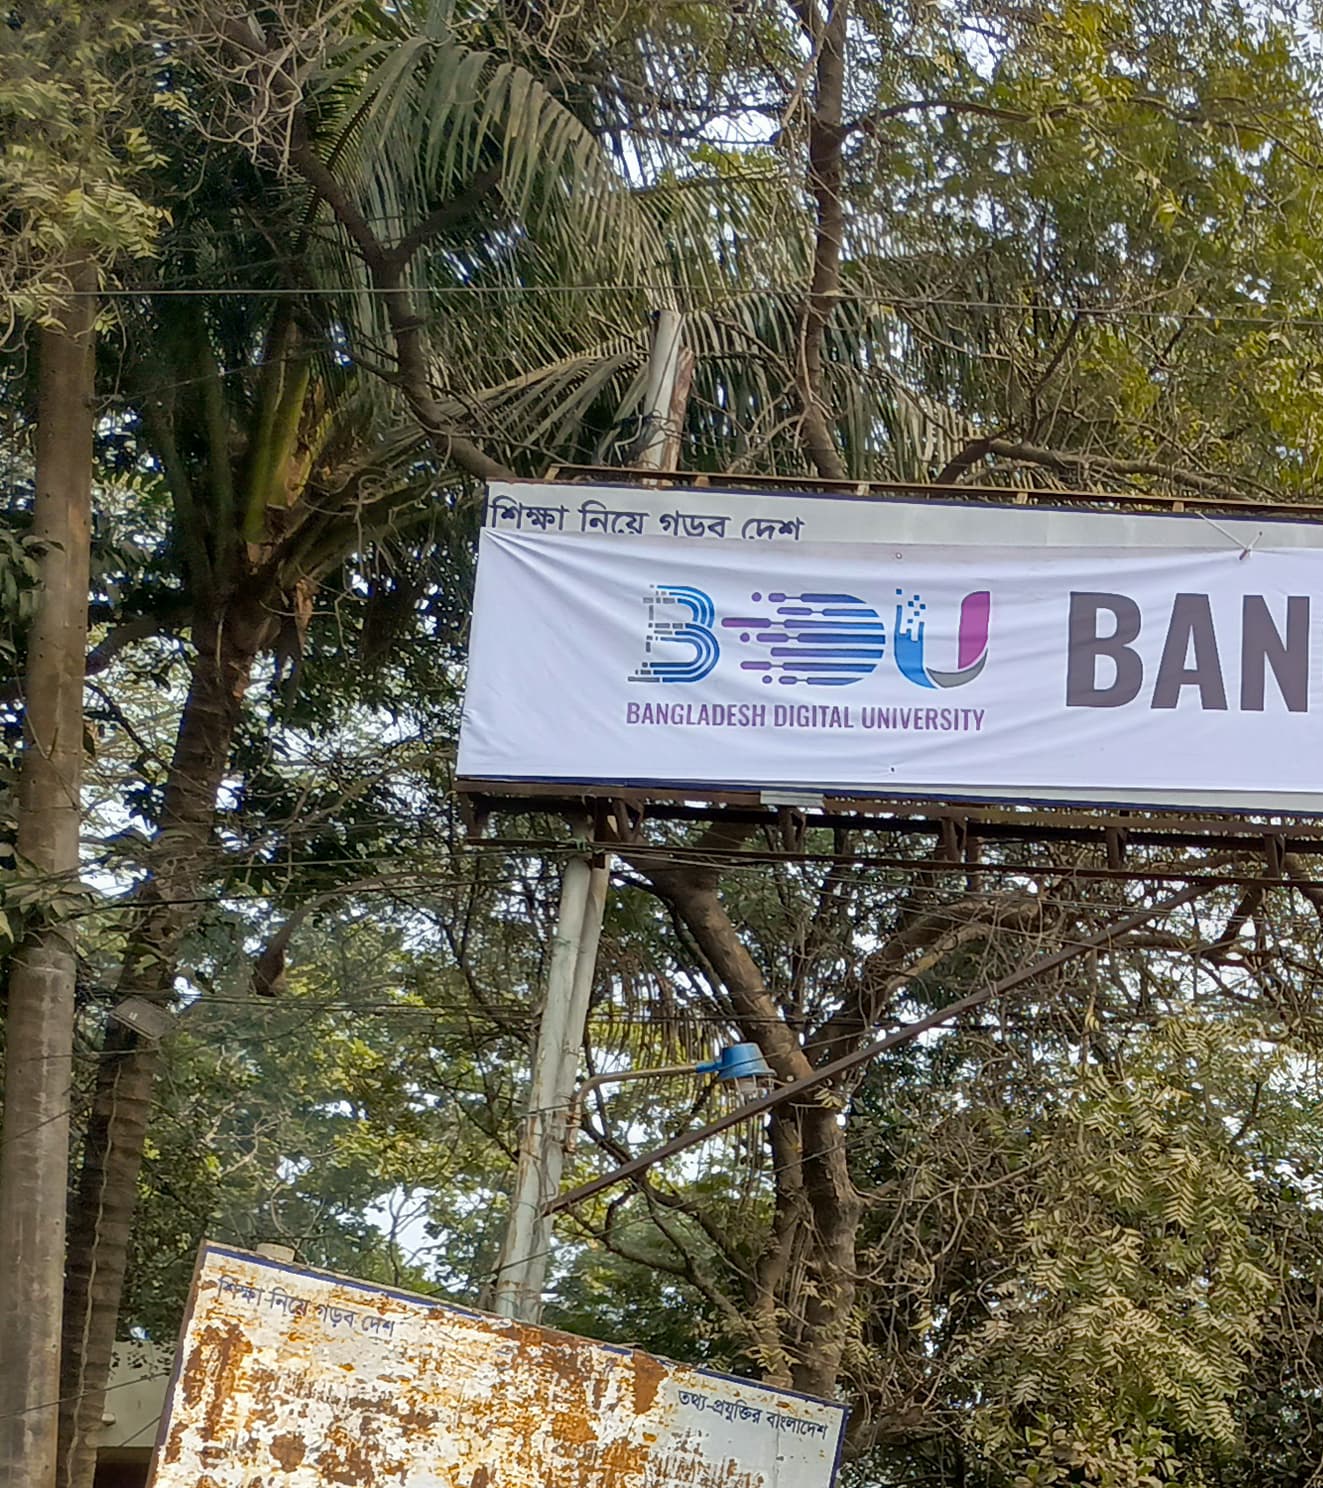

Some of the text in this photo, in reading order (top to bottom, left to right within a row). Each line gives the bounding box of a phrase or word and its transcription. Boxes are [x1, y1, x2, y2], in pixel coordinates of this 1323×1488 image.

[488, 495, 569, 531] শিক্ষা
[578, 499, 650, 534] নিয়ে
[741, 516, 805, 541] দেশ
[626, 701, 986, 732] BANGLADESH DIGITAL UNIVERSITY
[361, 1314, 396, 1338] দেশ
[765, 1410, 829, 1441] বাংলাদেশ
